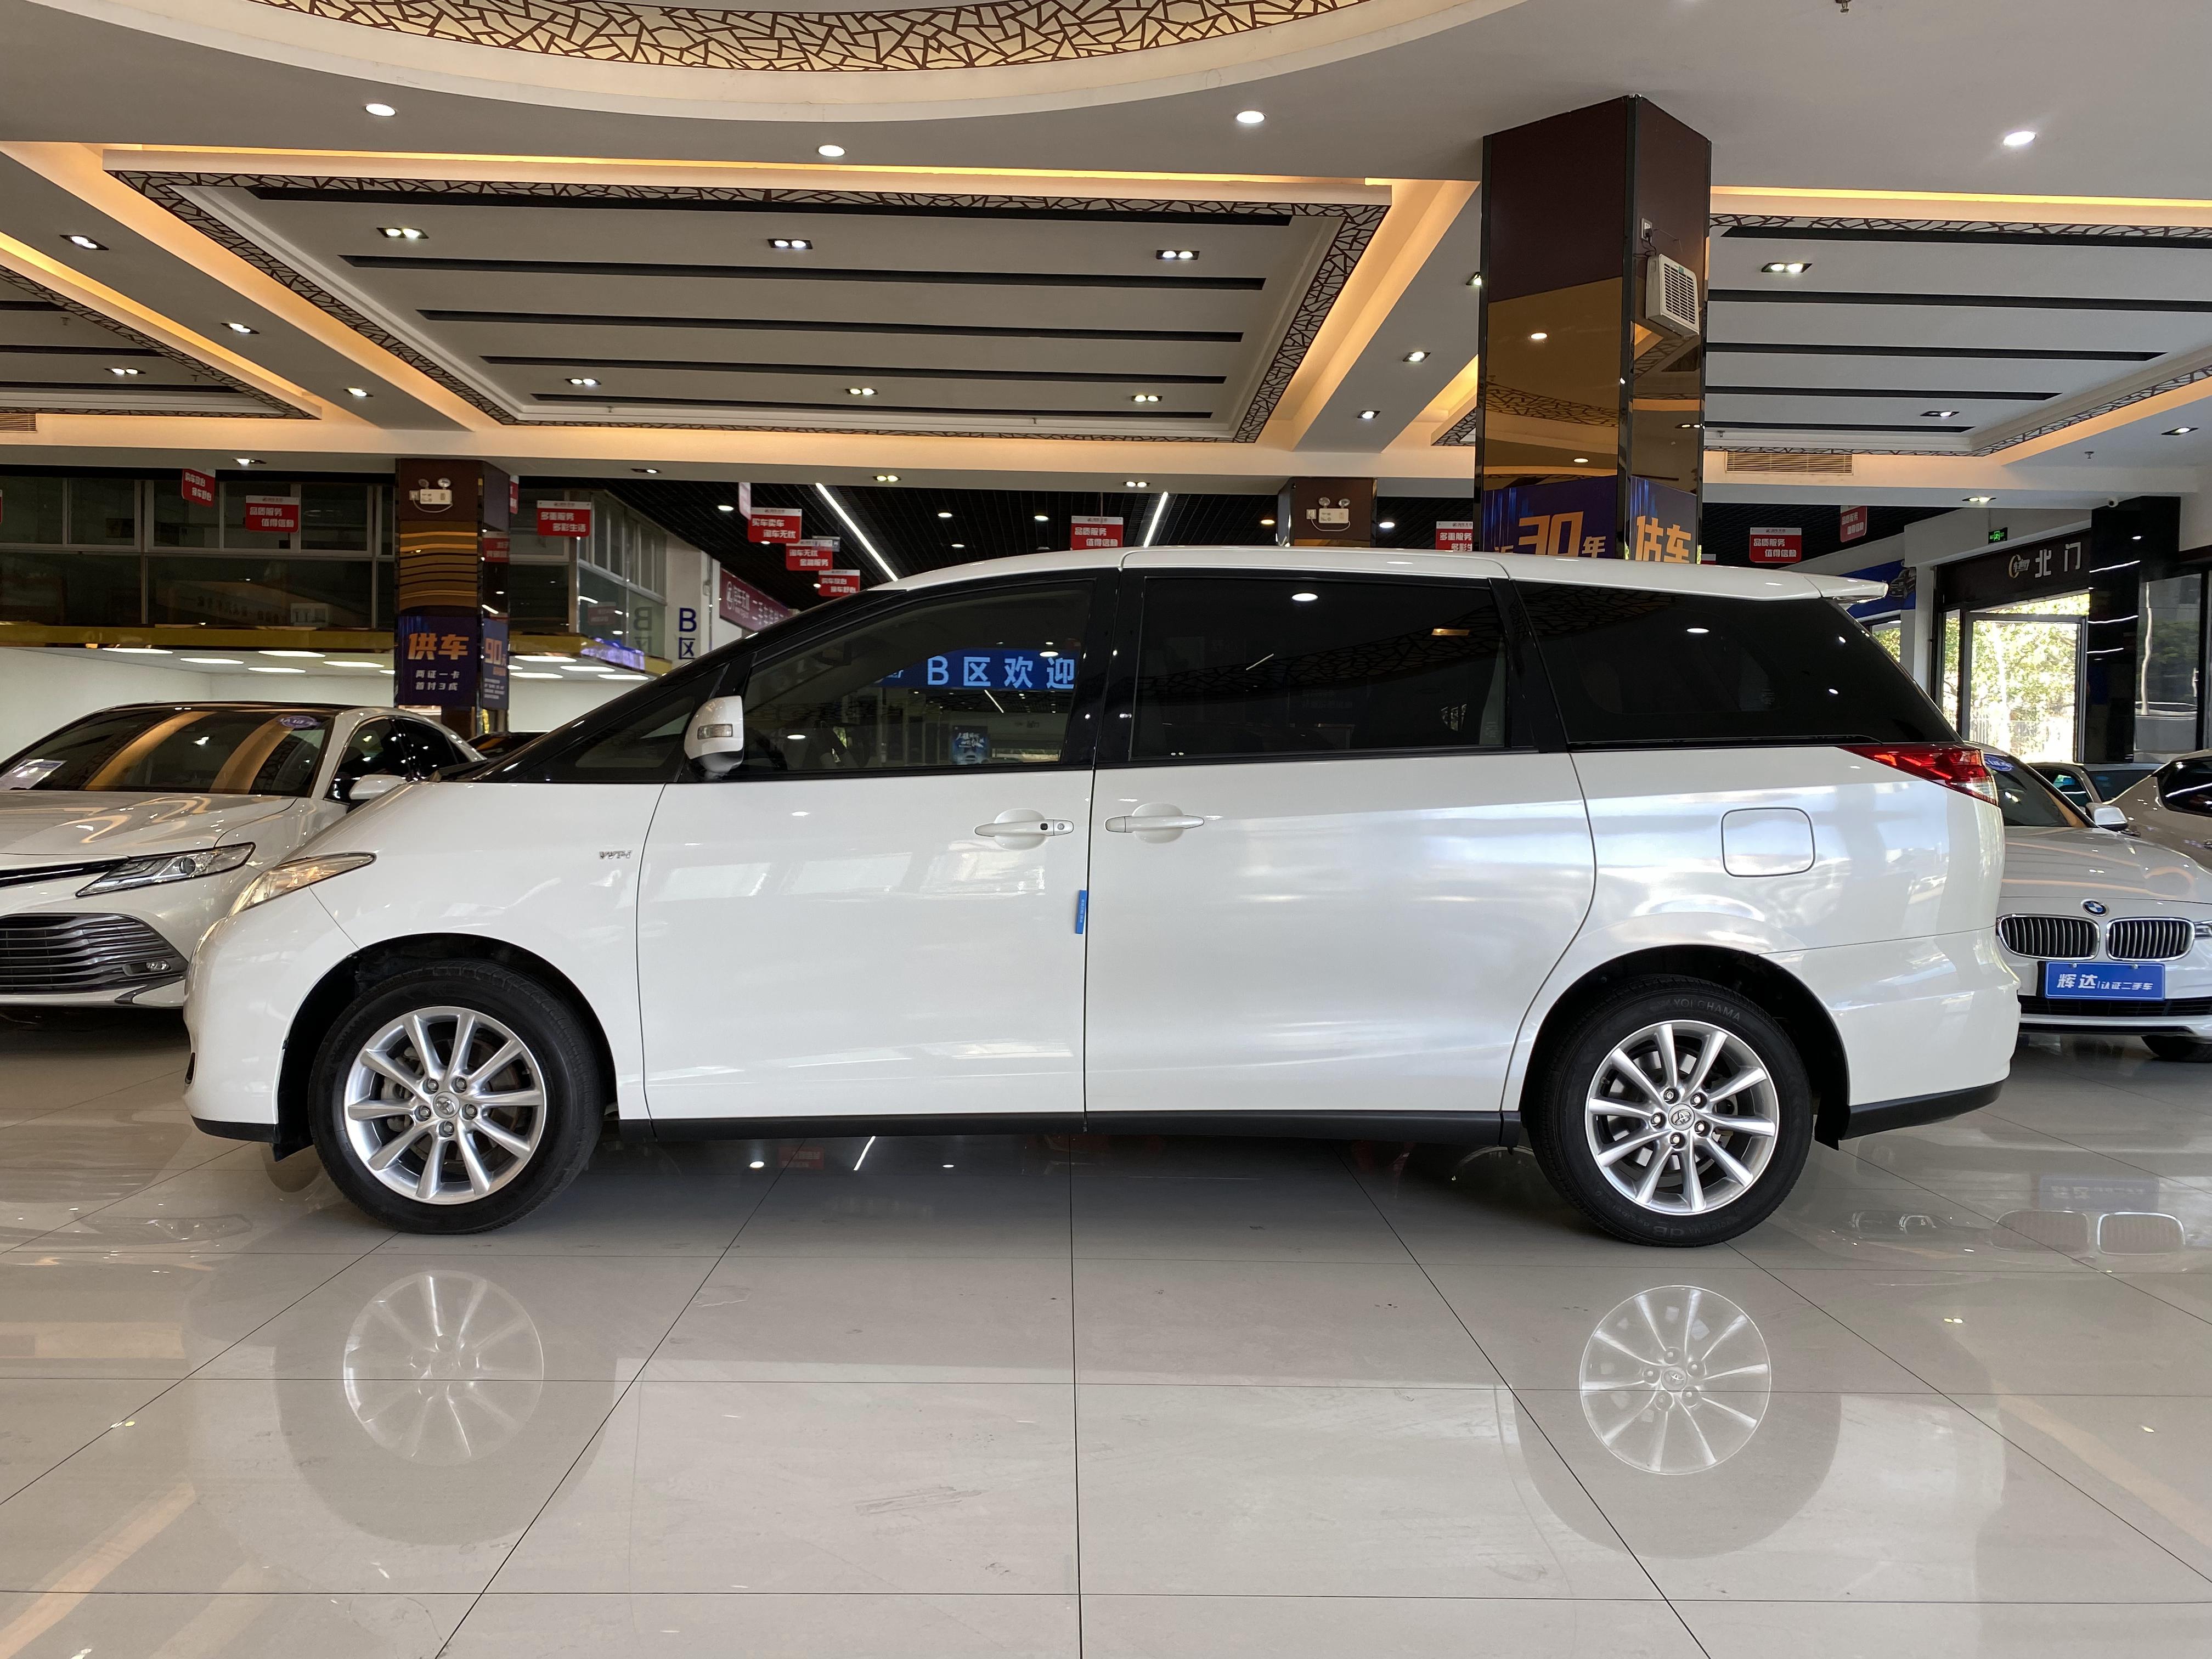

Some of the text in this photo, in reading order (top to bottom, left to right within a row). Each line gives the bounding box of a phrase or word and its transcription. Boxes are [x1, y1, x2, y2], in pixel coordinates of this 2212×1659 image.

[552, 523, 586, 532] 多彩生活
[1753, 538, 1785, 547] 品质服务
[2034, 541, 2081, 578] 北门
[679, 607, 697, 660] B区
[407, 633, 470, 661] 供车
[416, 669, 460, 679] 两证一卡
[927, 656, 1075, 689] B区欢迎
[415, 681, 459, 691] 首付3成
[2057, 973, 2154, 991] 辉达 认证二手车
